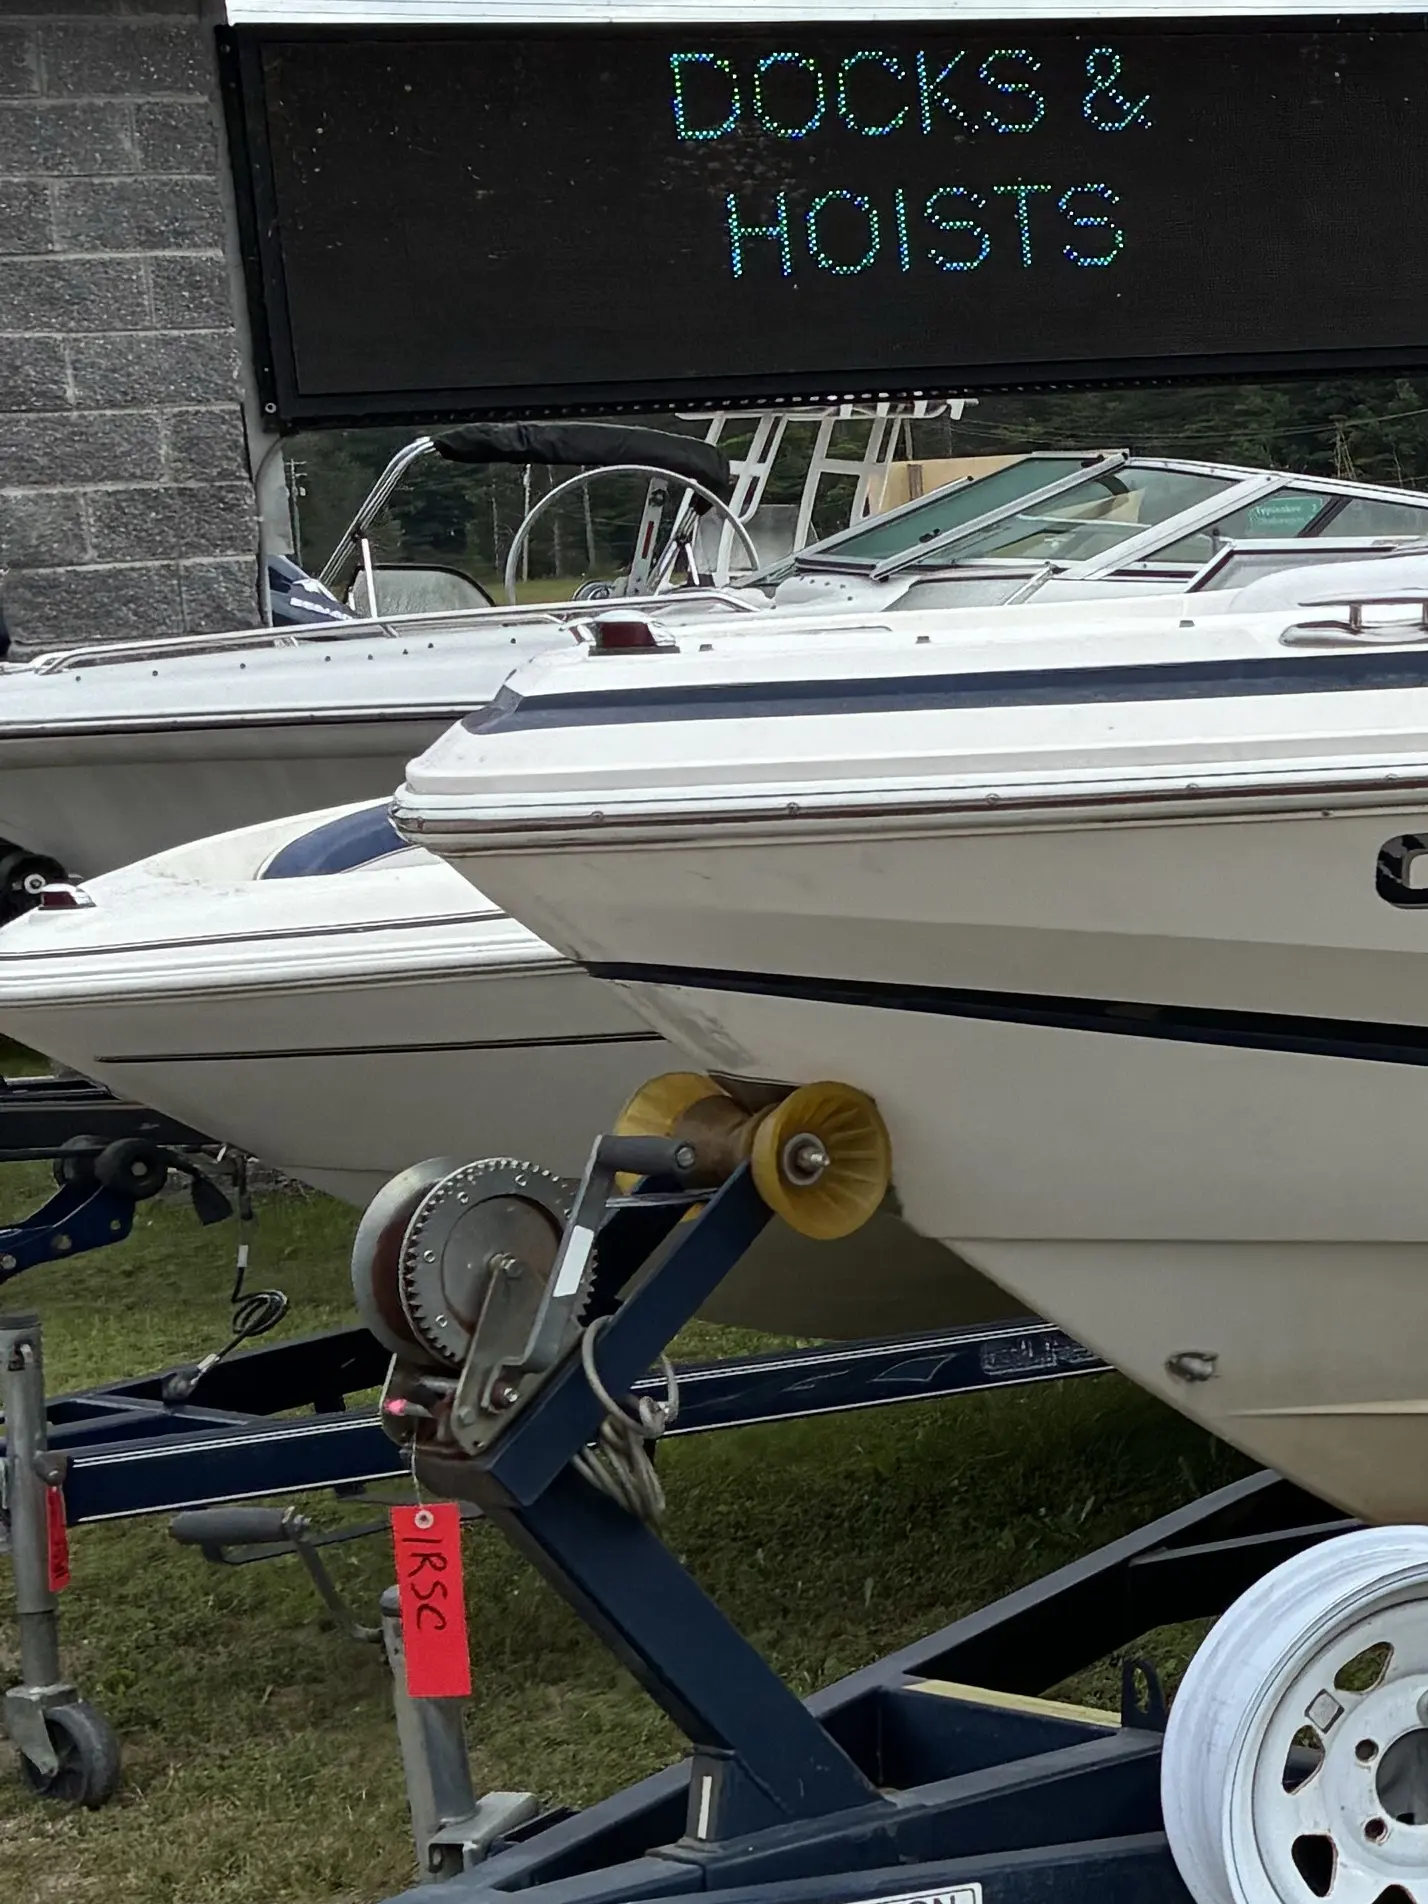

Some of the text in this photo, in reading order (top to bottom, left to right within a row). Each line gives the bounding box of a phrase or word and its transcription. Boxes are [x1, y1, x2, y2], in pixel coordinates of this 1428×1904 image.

[669, 47, 1153, 140] DOCKS &
[724, 183, 1125, 278] HOISTS
